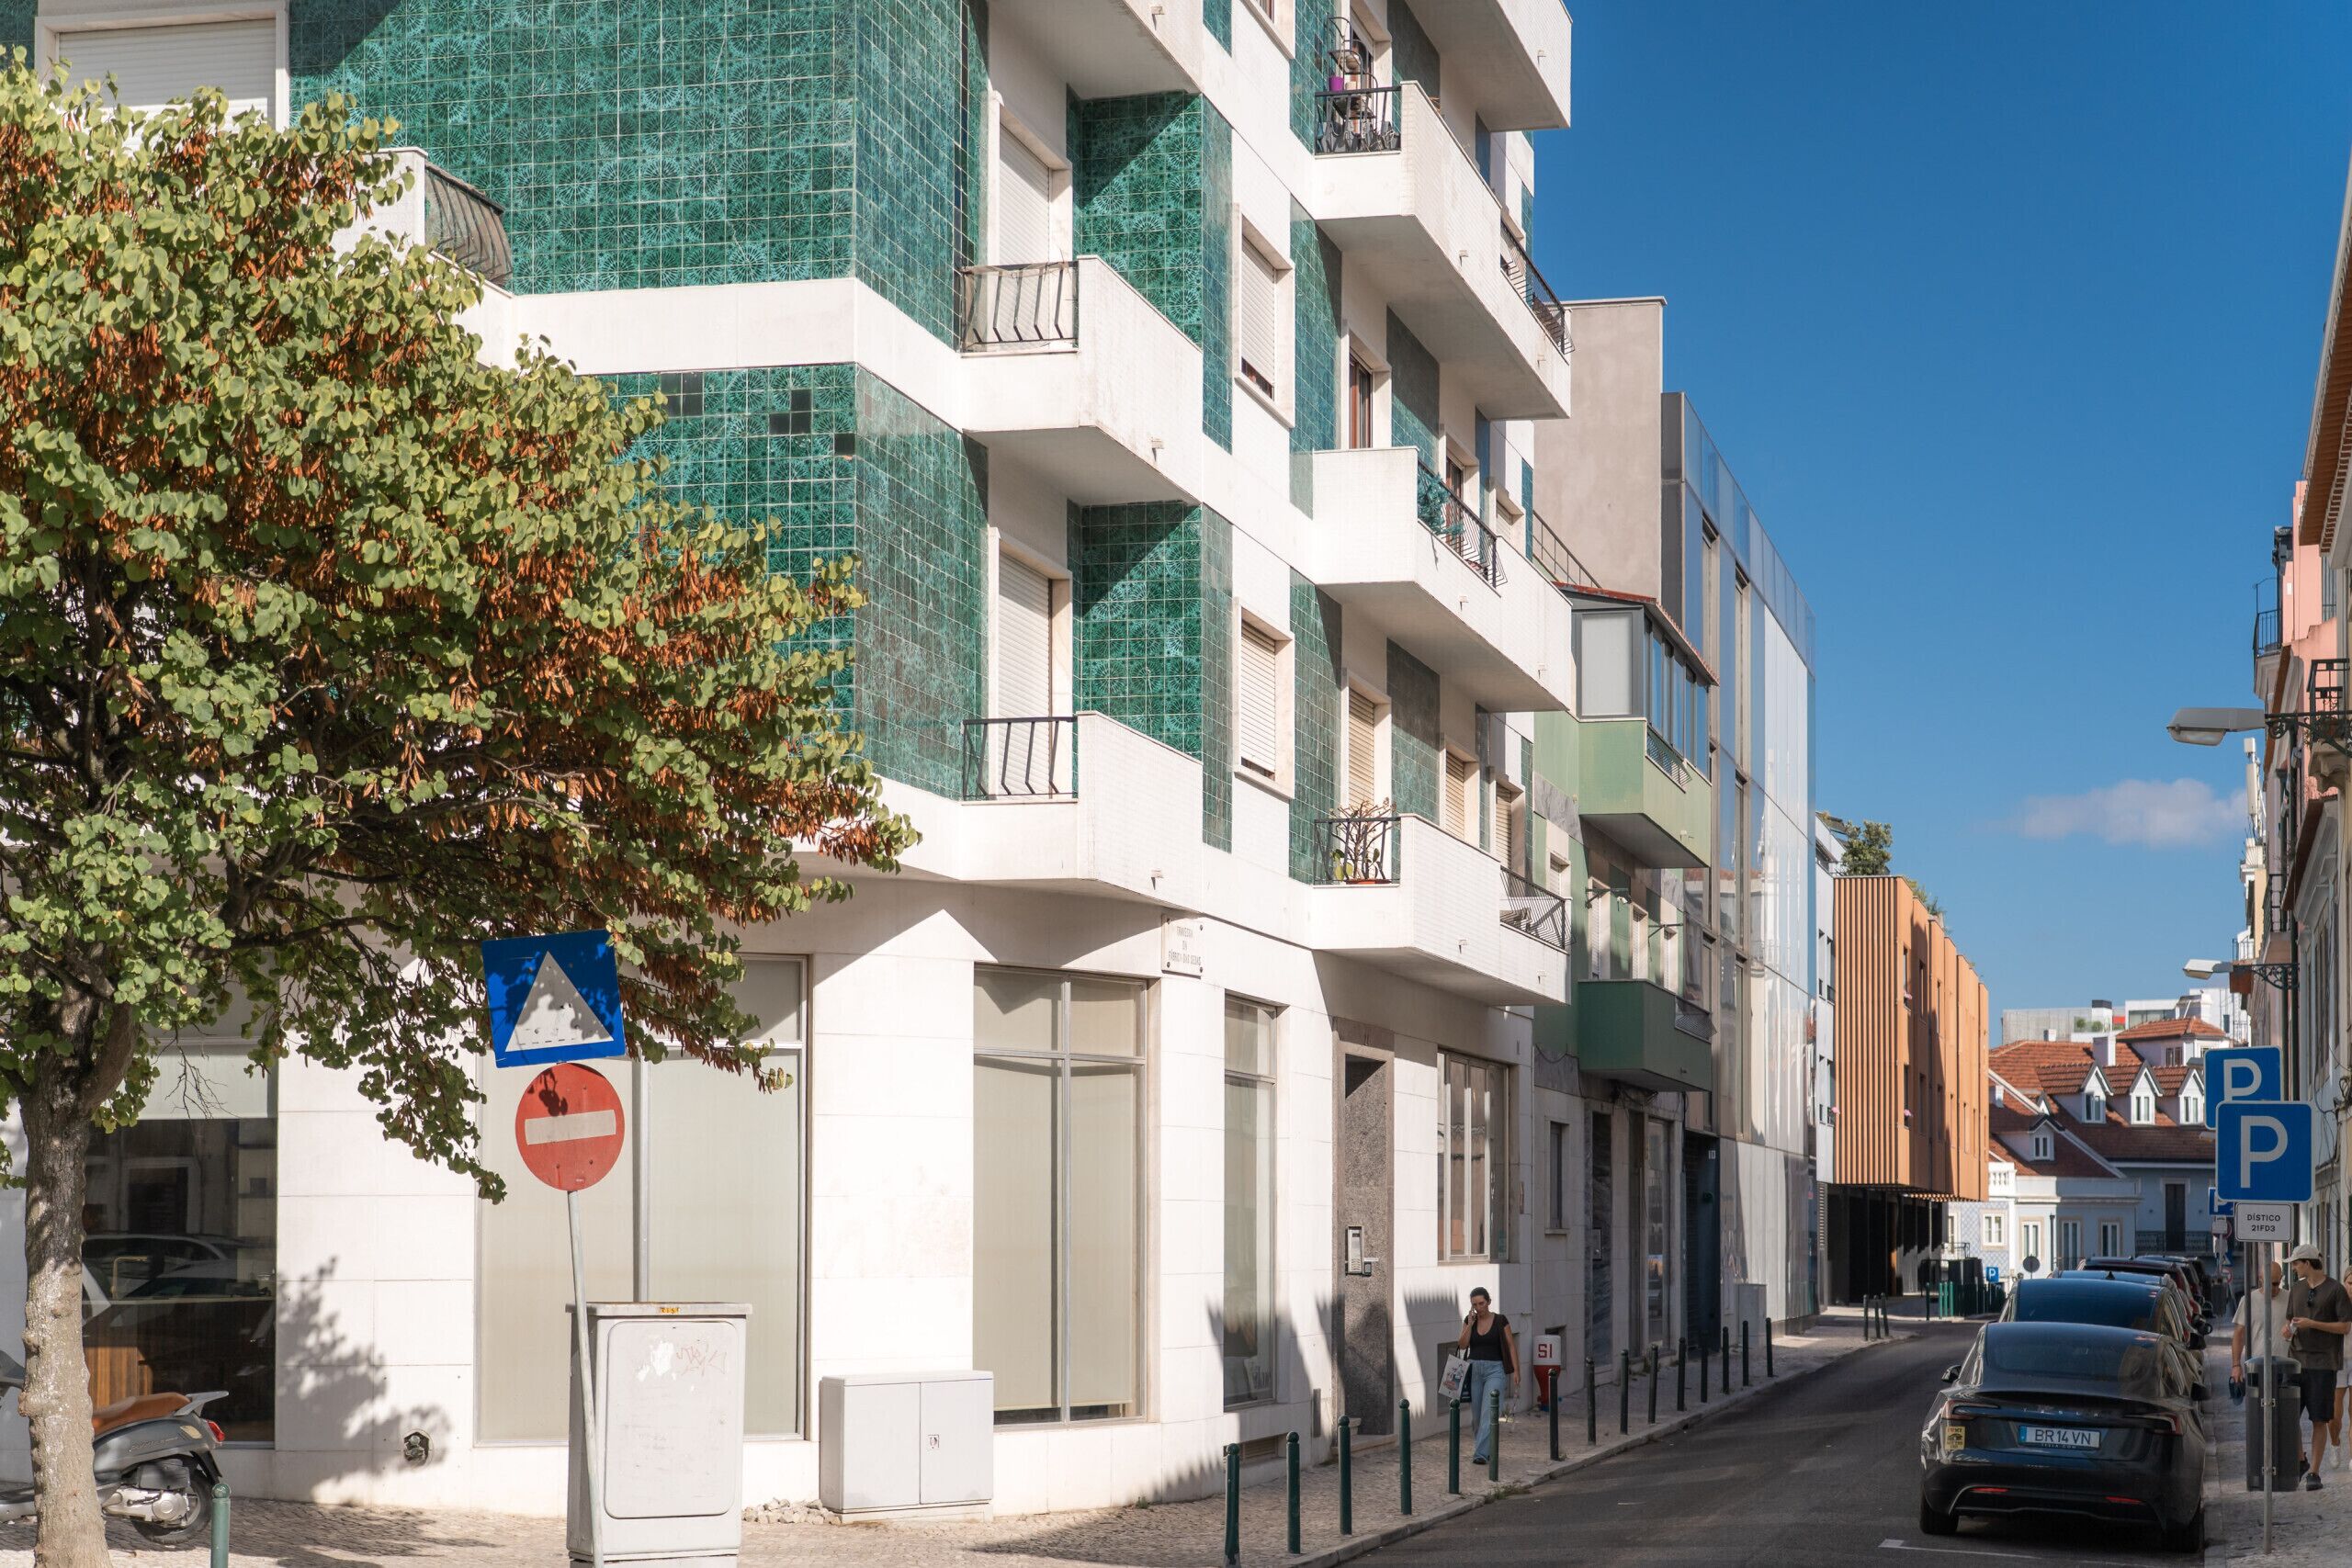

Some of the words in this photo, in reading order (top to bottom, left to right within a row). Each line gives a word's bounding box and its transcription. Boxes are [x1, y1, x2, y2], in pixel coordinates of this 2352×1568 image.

[2223, 1058, 2262, 1102] P
[2240, 1115, 2289, 1189] P
[2246, 1213, 2281, 1222] DÍSTICO
[1988, 1268, 1996, 1280] P
